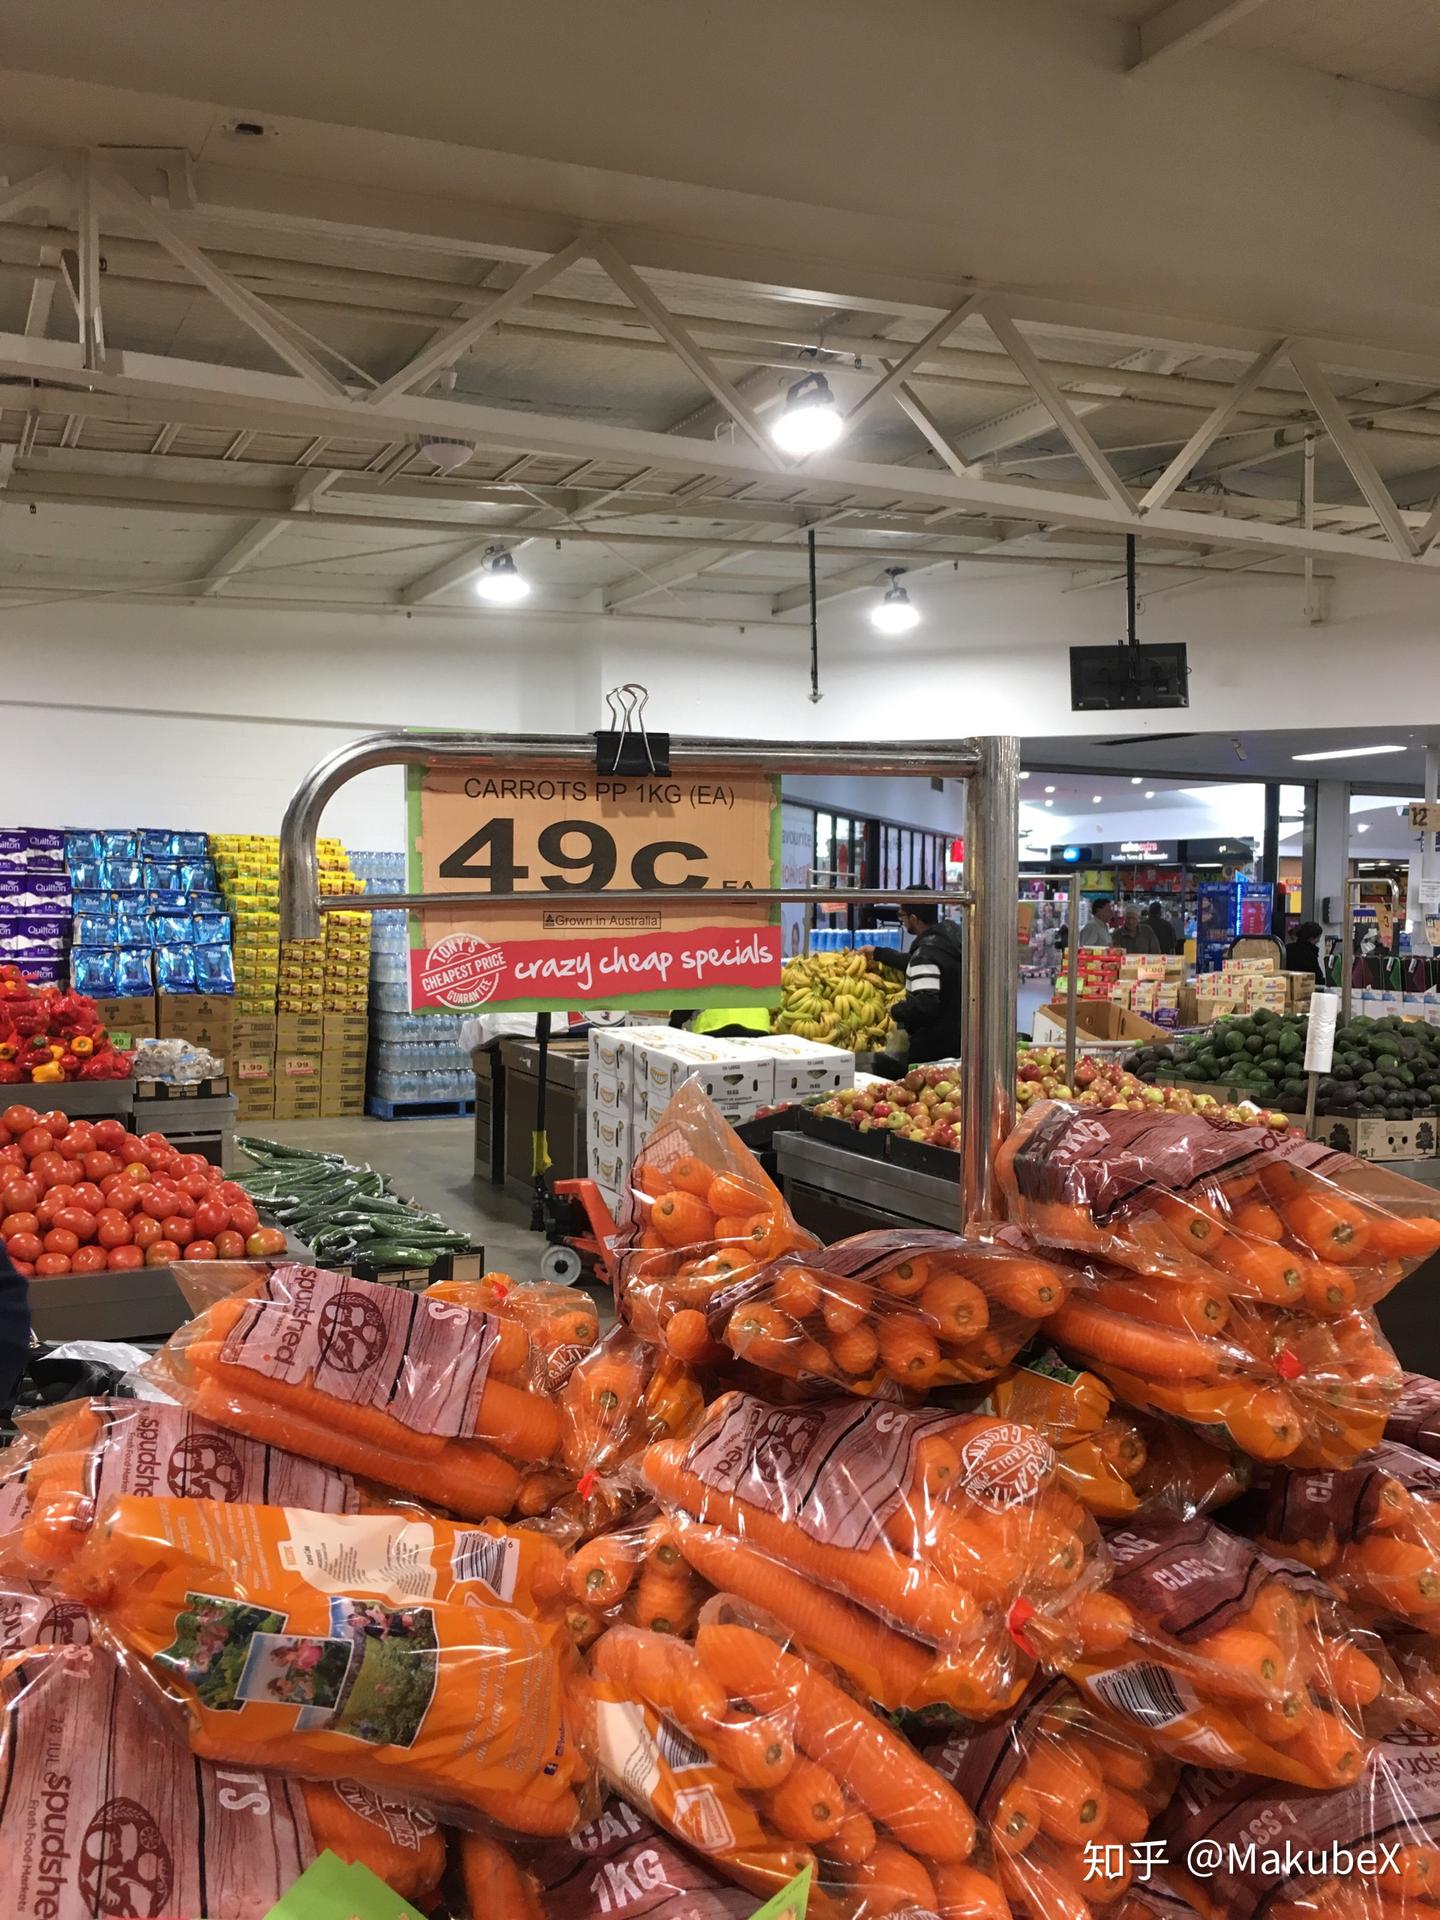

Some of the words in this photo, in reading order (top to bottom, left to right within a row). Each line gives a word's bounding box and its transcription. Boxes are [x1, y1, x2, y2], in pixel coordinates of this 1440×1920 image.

[464, 778, 587, 802] CARROTS
[596, 781, 627, 803] PP
[636, 782, 682, 804] 1KG
[690, 784, 735, 809] (EA)
[29, 834, 60, 847] Quilton
[36, 883, 67, 892] Quilton
[28, 926, 59, 935] Quilton
[555, 914, 596, 927] Grown
[598, 914, 607, 927] in
[609, 914, 658, 928] Australia
[432, 937, 478, 965] TONY'S
[514, 951, 593, 991] crazy
[600, 945, 673, 983] cheap
[681, 933, 774, 977] specials
[422, 963, 474, 992] CHEAPEST
[476, 952, 506, 974] PRICE
[448, 978, 493, 1005] GUARANTEE
[273, 1268, 317, 1367] spudshed
[133, 1418, 163, 1498] spudshe
[1151, 1560, 1206, 1592] CLASS
[28, 1800, 40, 1829] Fresh
[24, 1831, 36, 1863] Food
[33, 1774, 72, 1920] spudshe
[17, 1864, 33, 1913] Markets
[589, 1849, 668, 1914] 1KG
